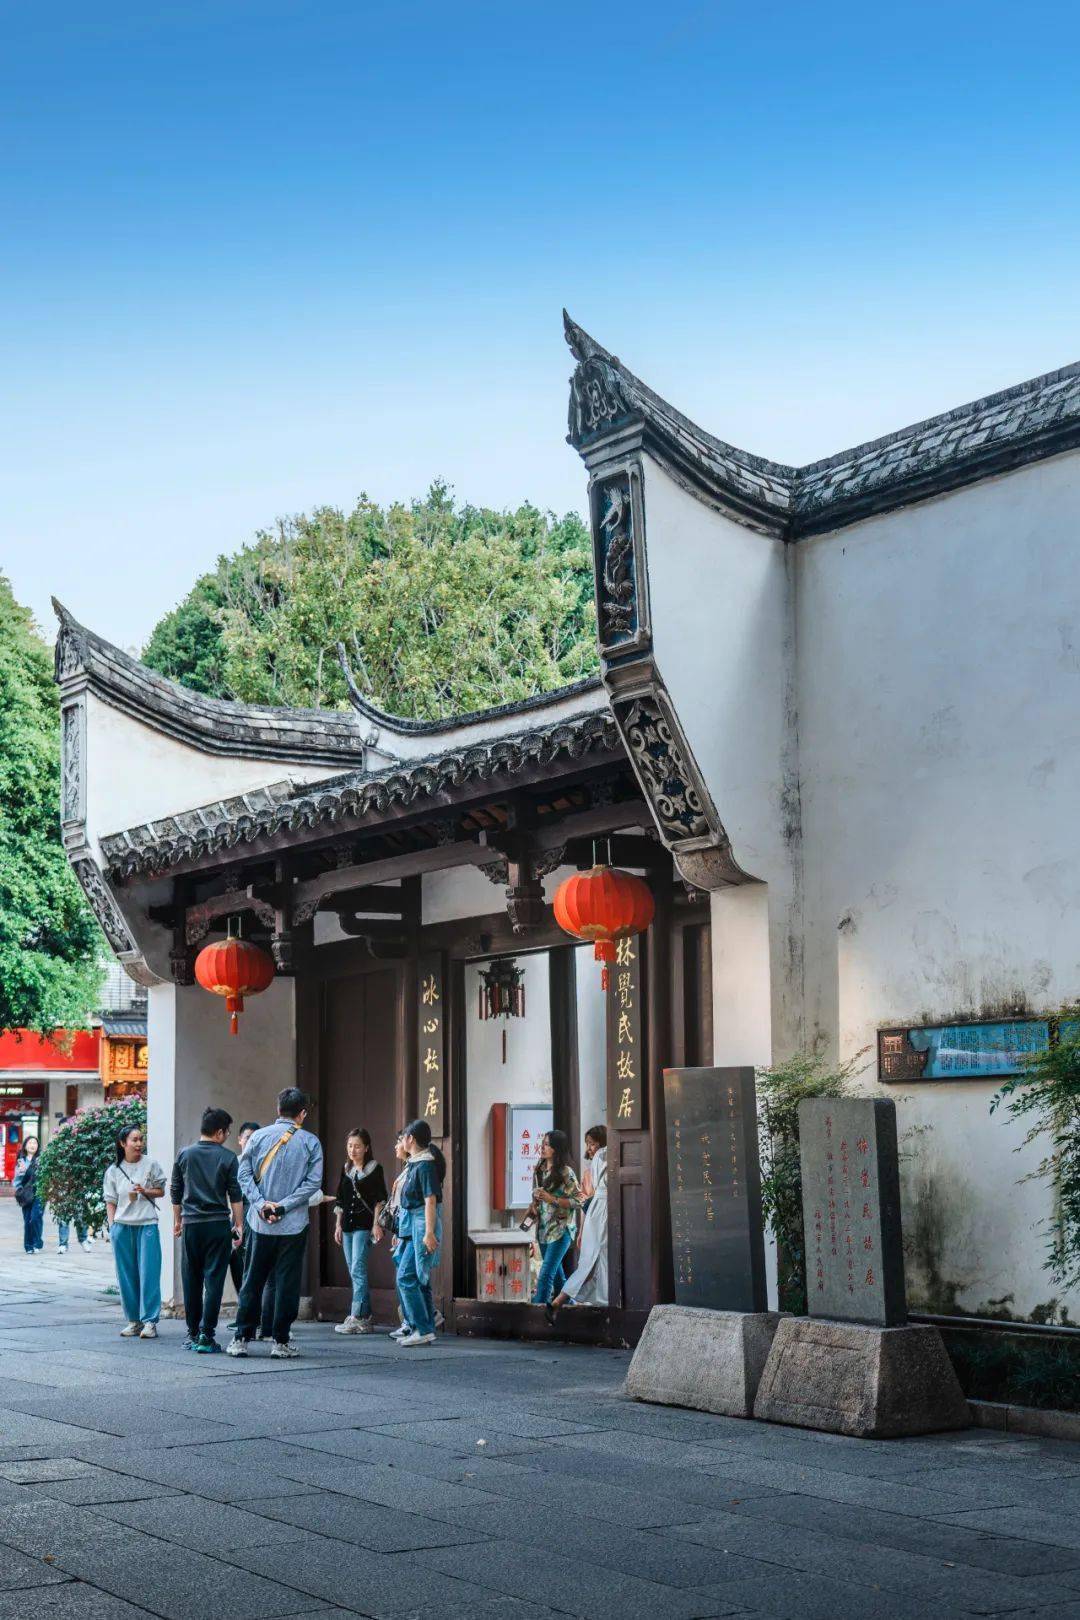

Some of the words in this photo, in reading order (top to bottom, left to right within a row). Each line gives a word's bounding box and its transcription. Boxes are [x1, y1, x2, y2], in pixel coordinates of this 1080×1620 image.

[422, 974, 439, 1117] 冰心故居
[615, 936, 636, 1118] 林覺民故居
